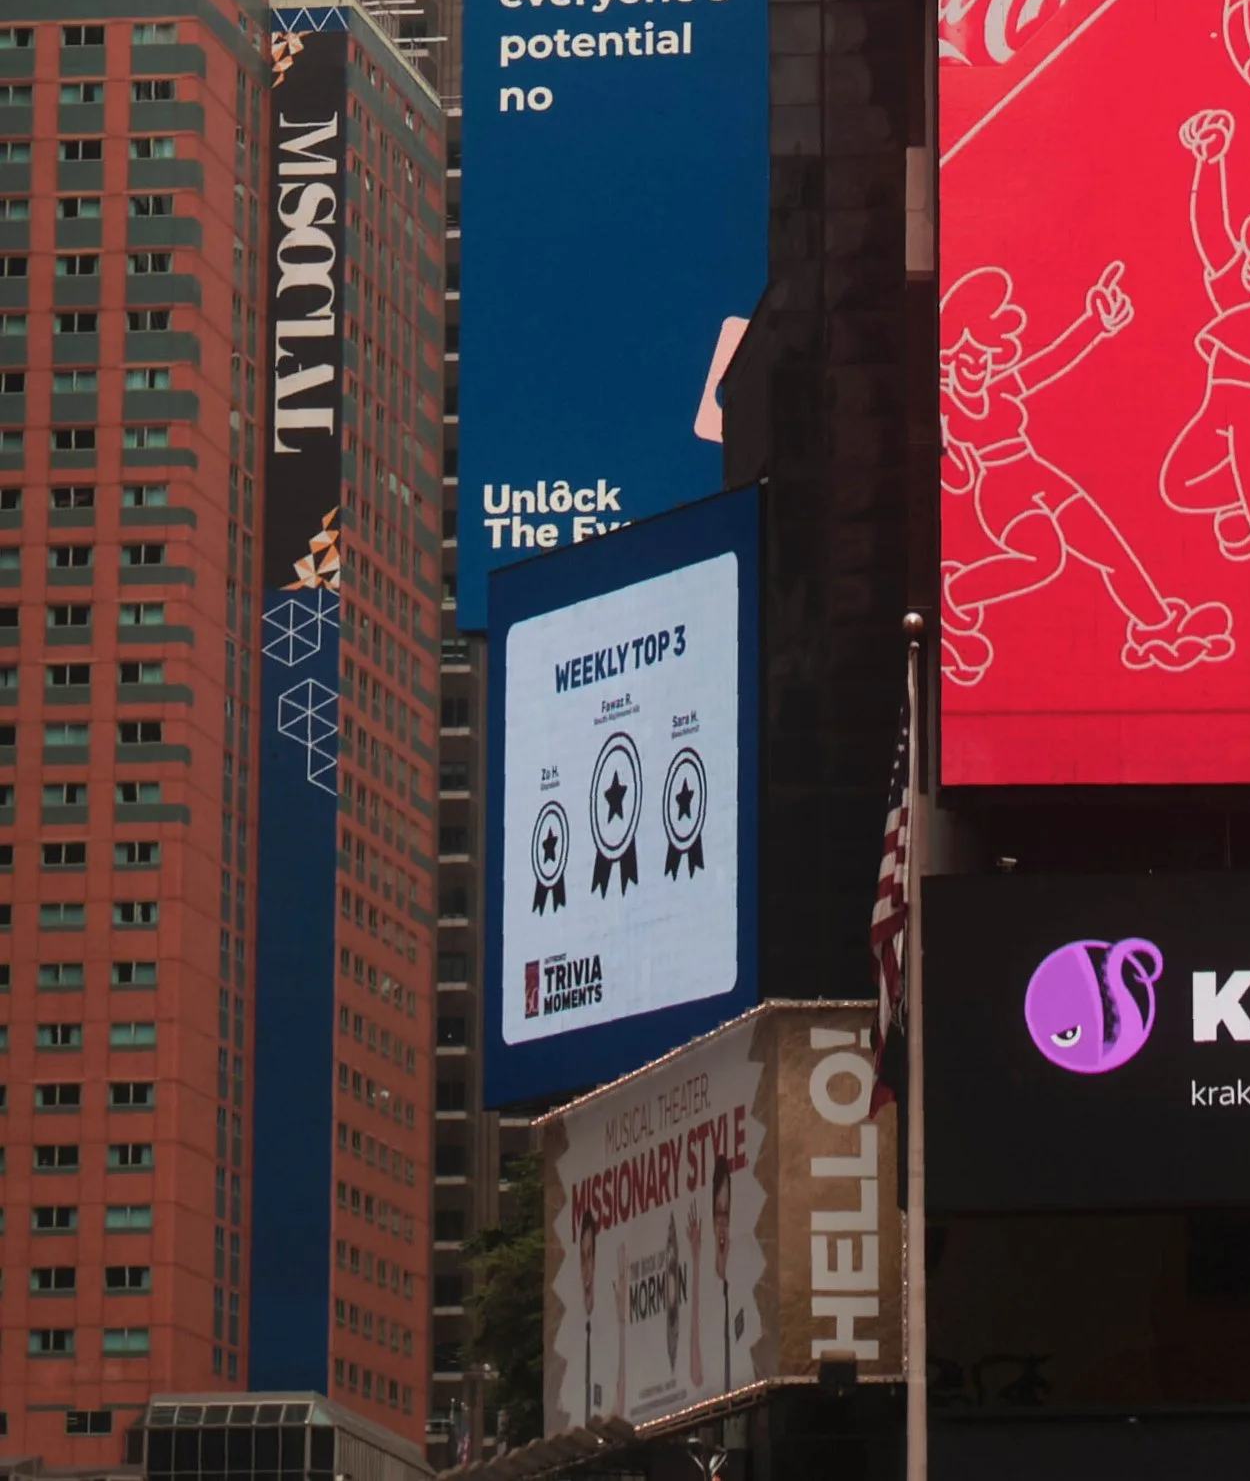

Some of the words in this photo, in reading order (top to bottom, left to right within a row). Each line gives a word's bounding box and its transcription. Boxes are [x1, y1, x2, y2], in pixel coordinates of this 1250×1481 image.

[500, 20, 692, 68] potential
[499, 86, 553, 112] no
[483, 516, 559, 549] The
[555, 642, 628, 694] WEEKLY
[631, 630, 670, 670] TOP
[673, 624, 686, 657] 3
[672, 714, 690, 728] Sara
[544, 954, 603, 994] TRIVIA
[543, 983, 603, 1016] MOMENTS
[605, 1099, 655, 1155] MUSICAL
[571, 1134, 683, 1243] MISSIONARY
[808, 1027, 880, 1360] HELLO!
[628, 1264, 688, 1325] MORMON
